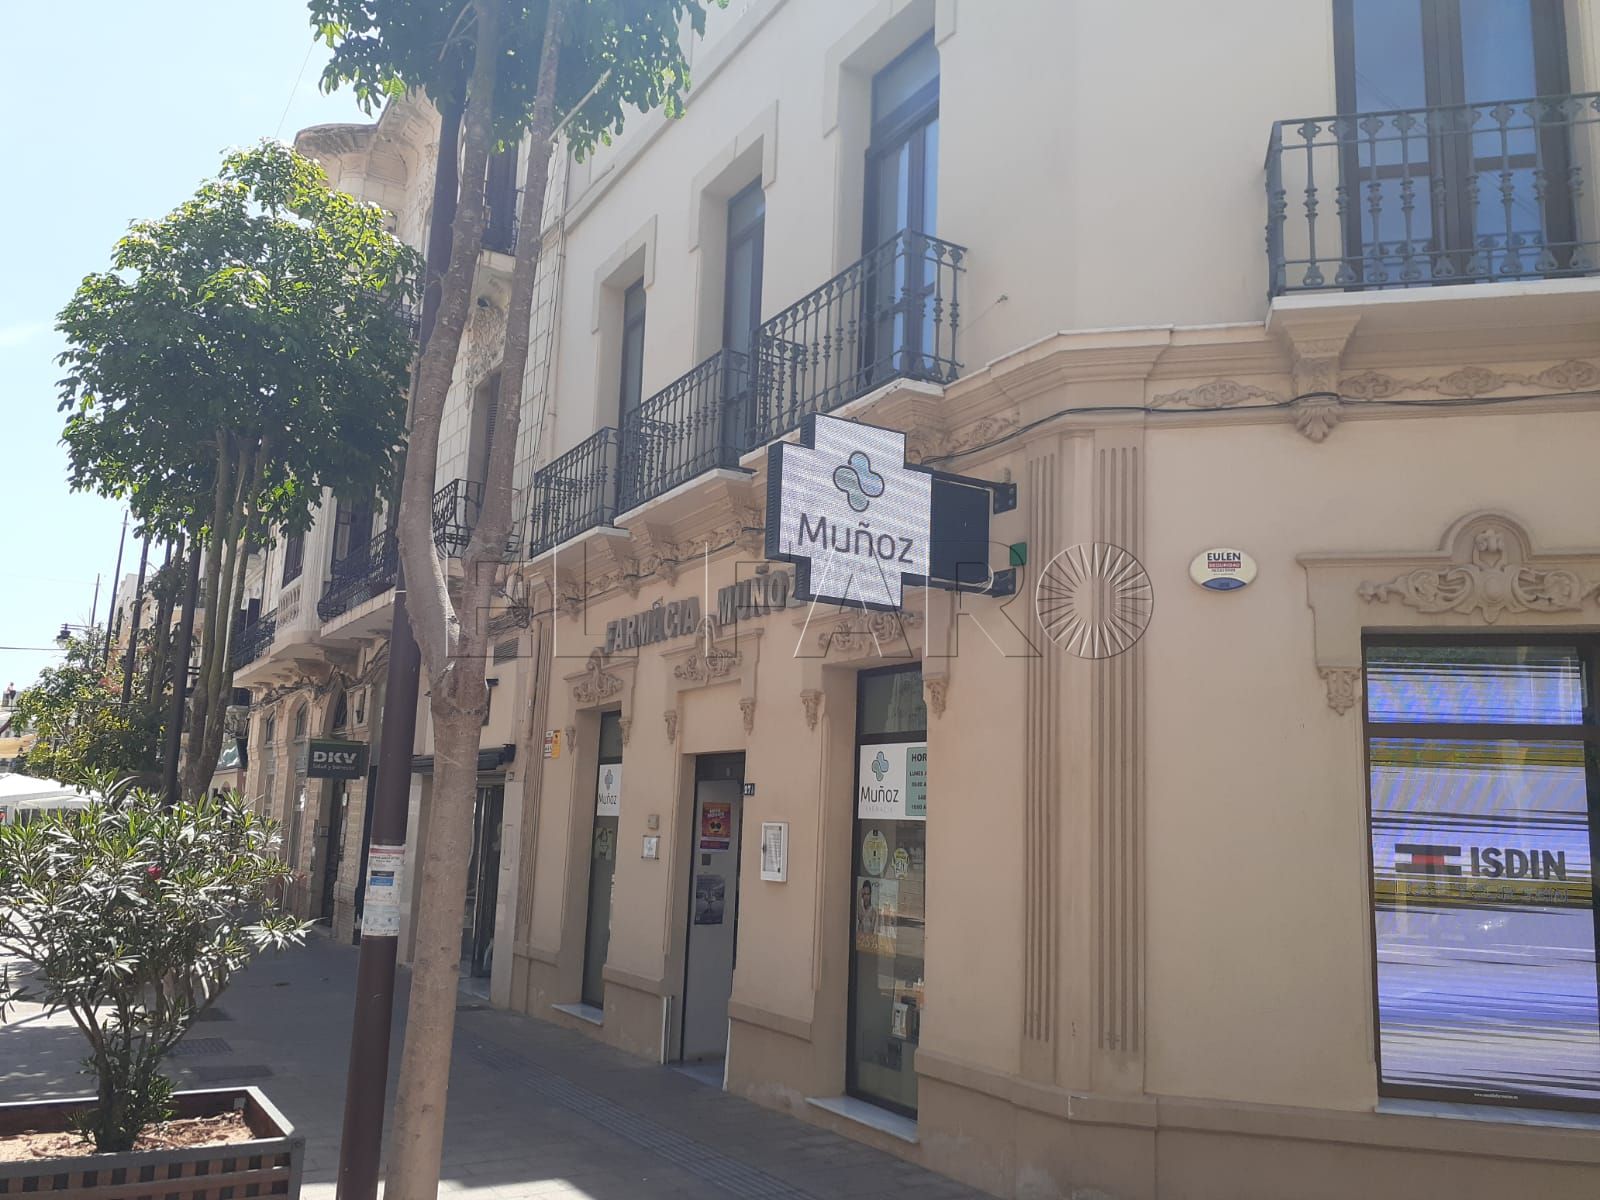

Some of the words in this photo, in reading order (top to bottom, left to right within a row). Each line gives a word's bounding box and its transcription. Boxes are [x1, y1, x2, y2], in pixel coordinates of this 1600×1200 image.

[797, 512, 914, 565] Muñoz
[1207, 552, 1241, 561] EULEN
[313, 751, 358, 764] DKV
[860, 785, 900, 803] Muñoz
[1470, 846, 1568, 881] ISDIN
